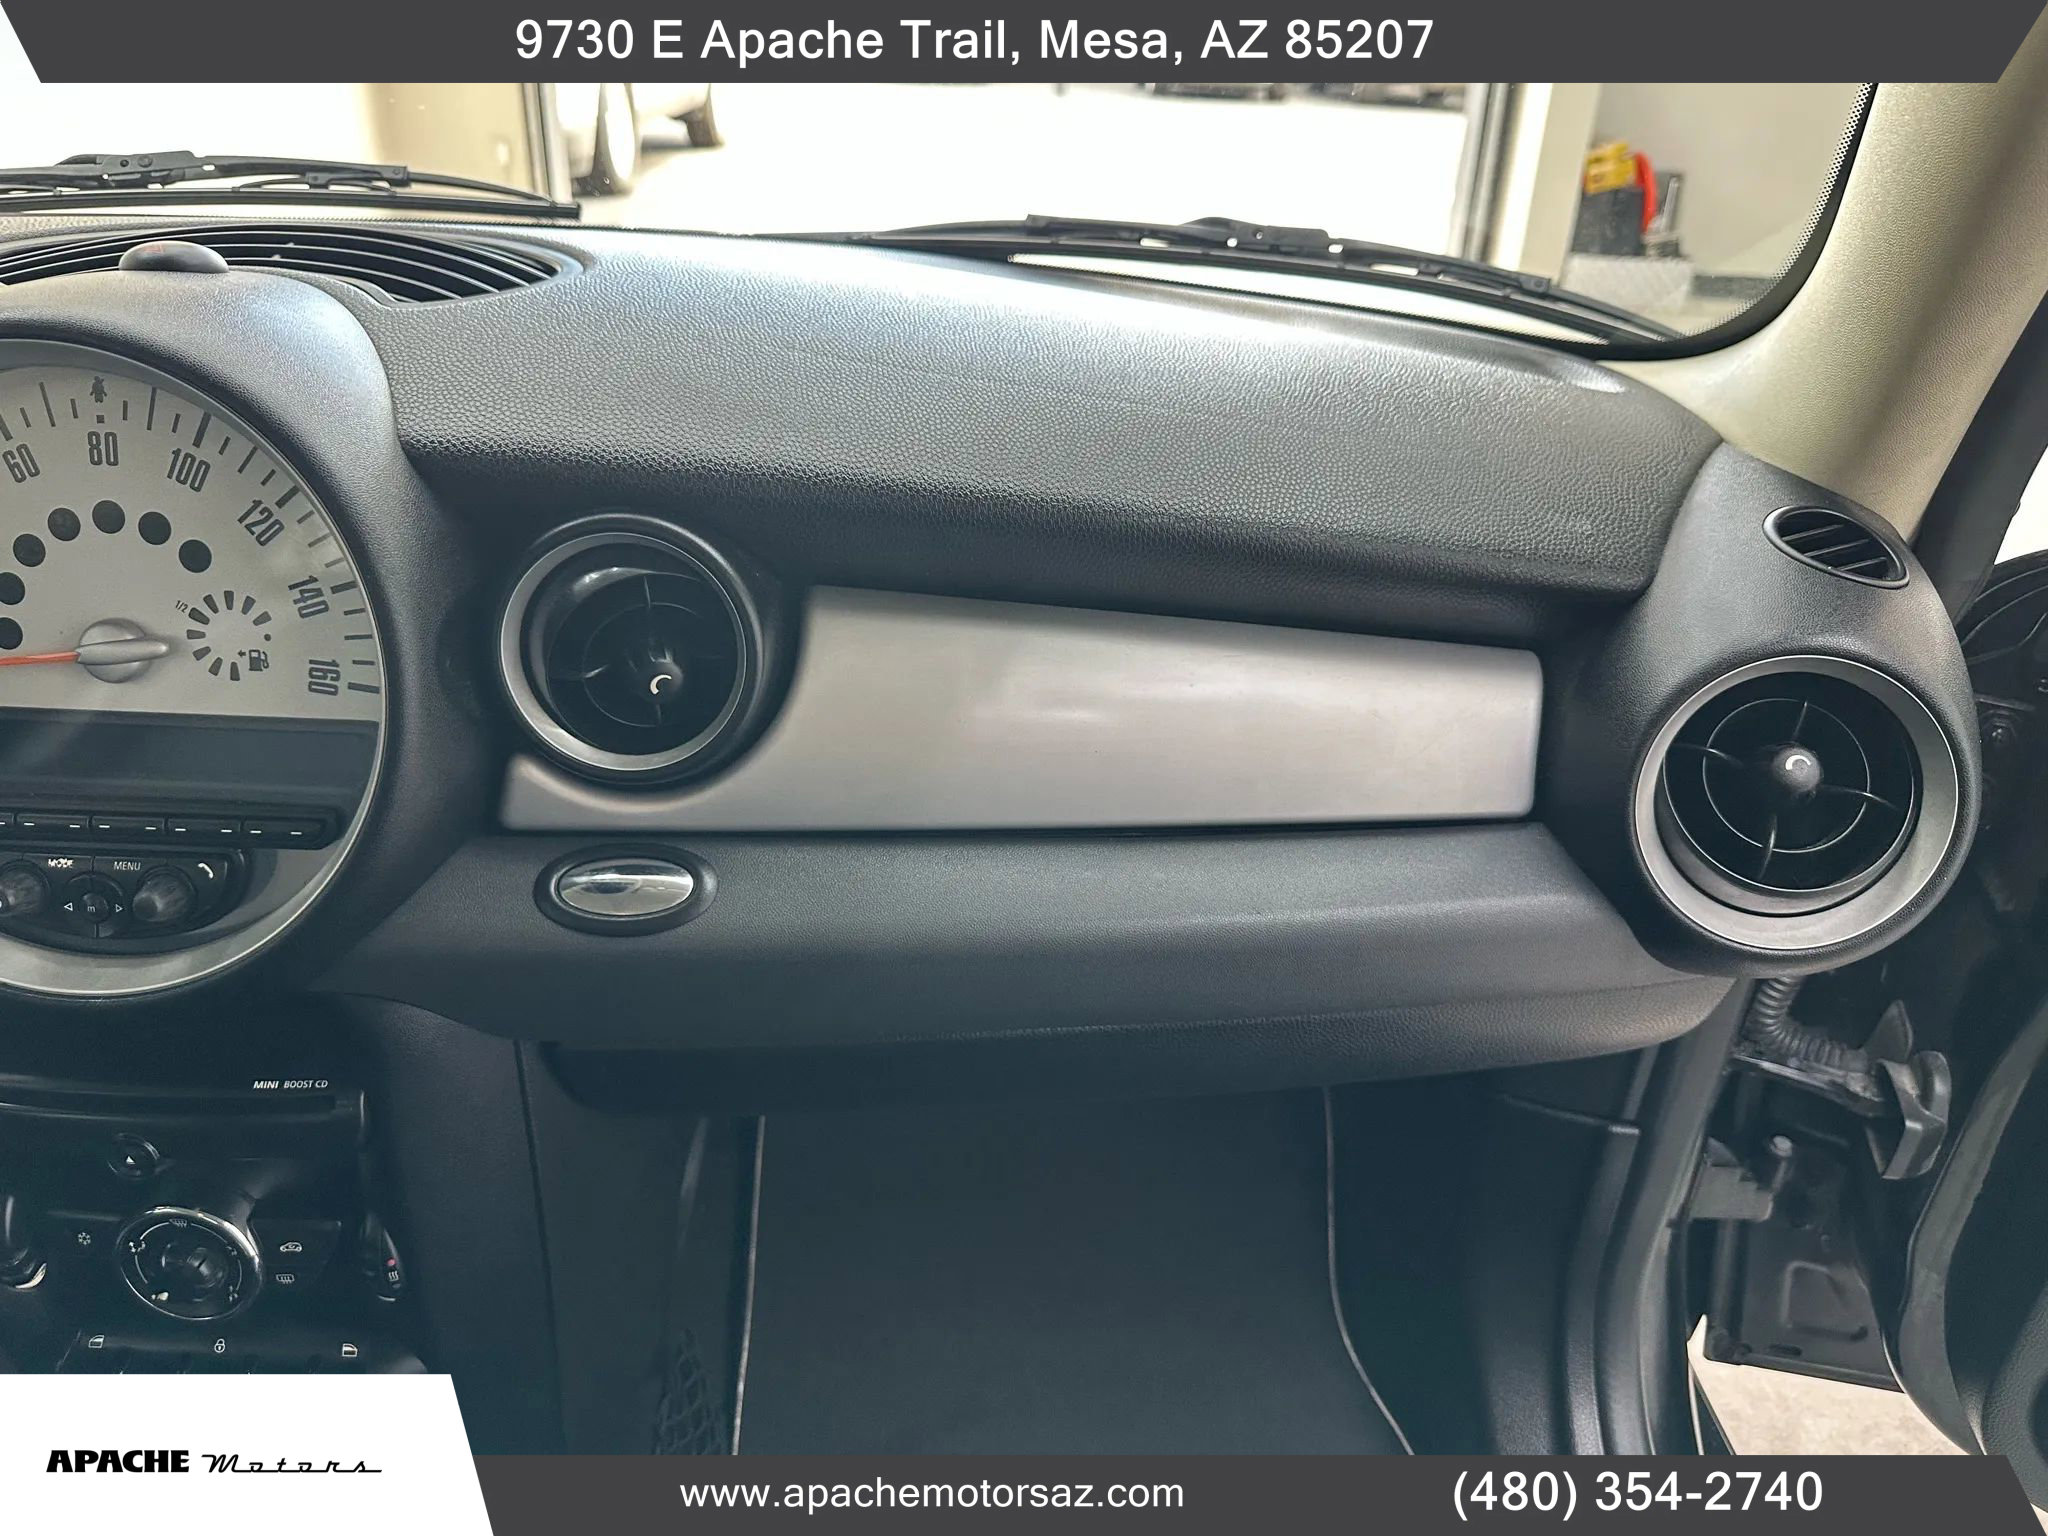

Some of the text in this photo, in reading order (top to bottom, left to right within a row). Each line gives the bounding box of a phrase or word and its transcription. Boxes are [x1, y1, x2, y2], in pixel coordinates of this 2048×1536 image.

[2, 443, 41, 483] 60
[87, 431, 119, 466] 80
[166, 448, 211, 492] 100
[236, 499, 285, 547] 120
[174, 600, 189, 614] 1/2
[288, 575, 329, 619] 140
[308, 658, 341, 696] 160
[113, 860, 141, 871] MENU
[253, 1079, 329, 1089] MINI BOOST CD
